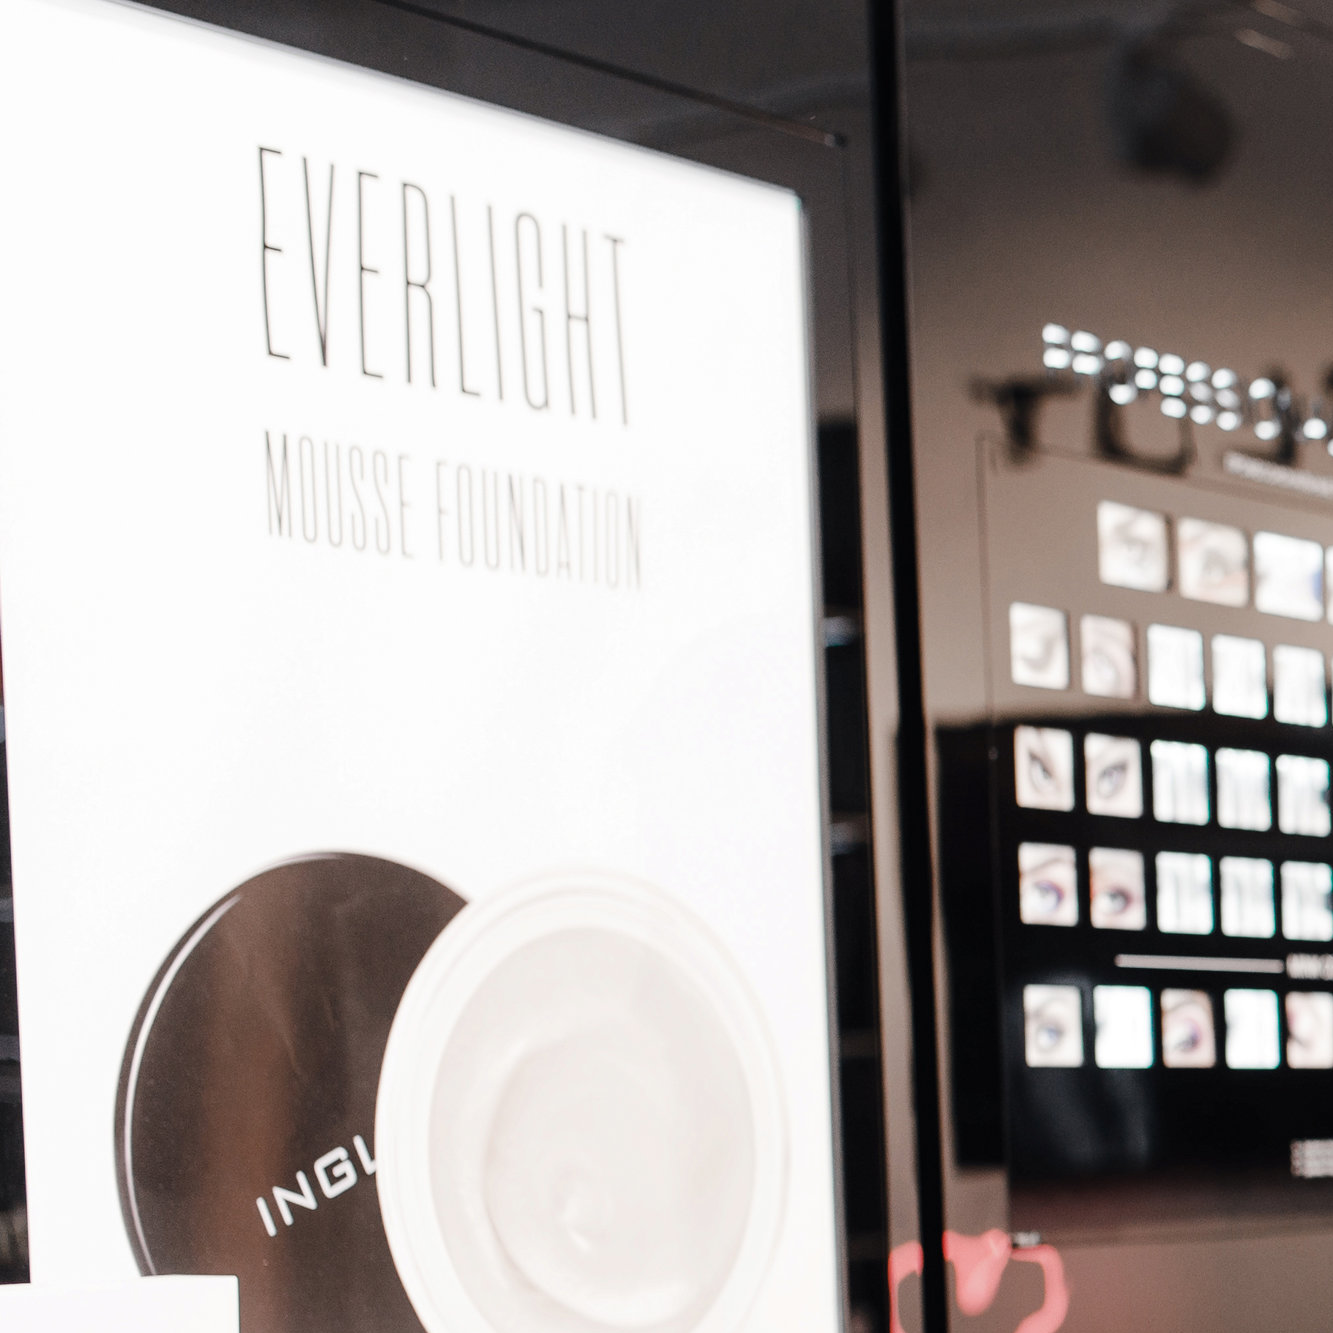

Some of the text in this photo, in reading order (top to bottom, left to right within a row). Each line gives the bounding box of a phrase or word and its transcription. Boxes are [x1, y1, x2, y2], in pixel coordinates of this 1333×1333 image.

[258, 145, 628, 427] EVERLIGHT
[264, 429, 643, 592] MOUSSE FOUNDATION
